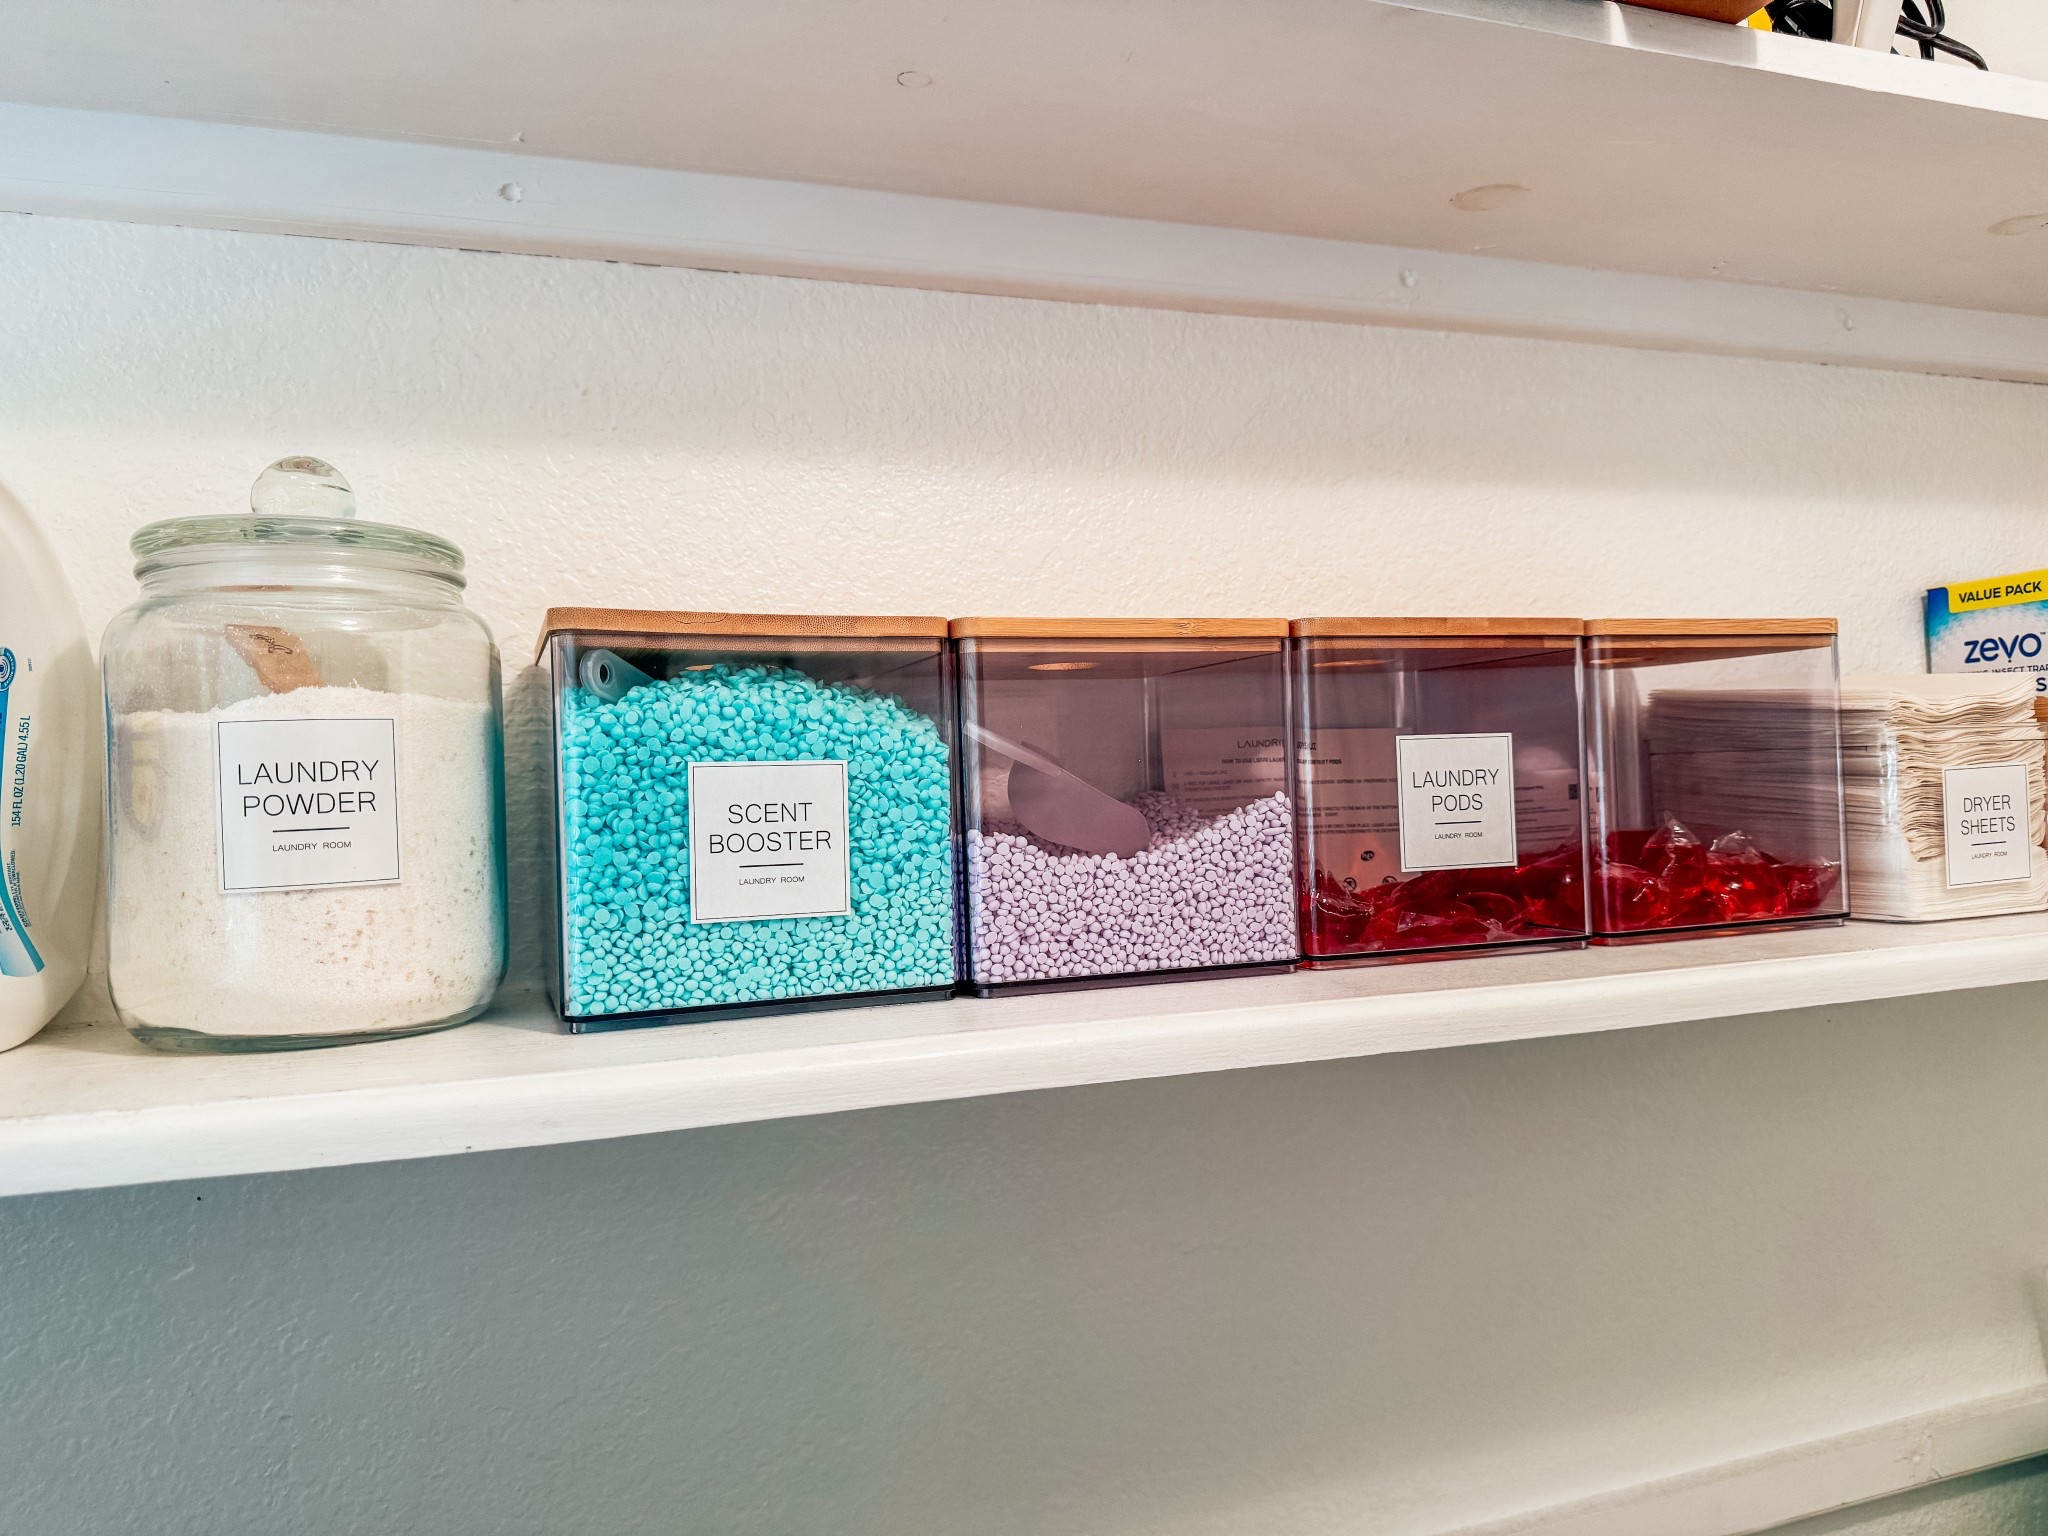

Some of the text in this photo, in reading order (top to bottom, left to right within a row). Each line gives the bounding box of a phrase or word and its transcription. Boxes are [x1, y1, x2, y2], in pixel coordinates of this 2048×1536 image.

[1958, 580, 2043, 604] VALUE PACK
[1963, 633, 2042, 664] zevo
[18, 721, 30, 741] 4.55
[16, 742, 29, 763] GAL)
[238, 759, 379, 785] LAUNDRY
[1412, 768, 1500, 789] LAUNDRY
[13, 786, 24, 798] OZ
[13, 799, 22, 809] FL
[243, 791, 377, 817] POWDER
[1431, 793, 1483, 812] PODS
[1963, 794, 2011, 813] DRYER
[12, 810, 22, 827] 154
[728, 802, 813, 824] SCENT
[1434, 832, 1462, 840] LAUNDRY
[1960, 816, 2016, 836] SHEETS
[272, 841, 352, 852] LAUNDRY ROOM
[709, 830, 832, 854] BOOSTER
[1971, 852, 1992, 860] LAUNDRY
[739, 875, 805, 886] LAUNDRY ROOM
